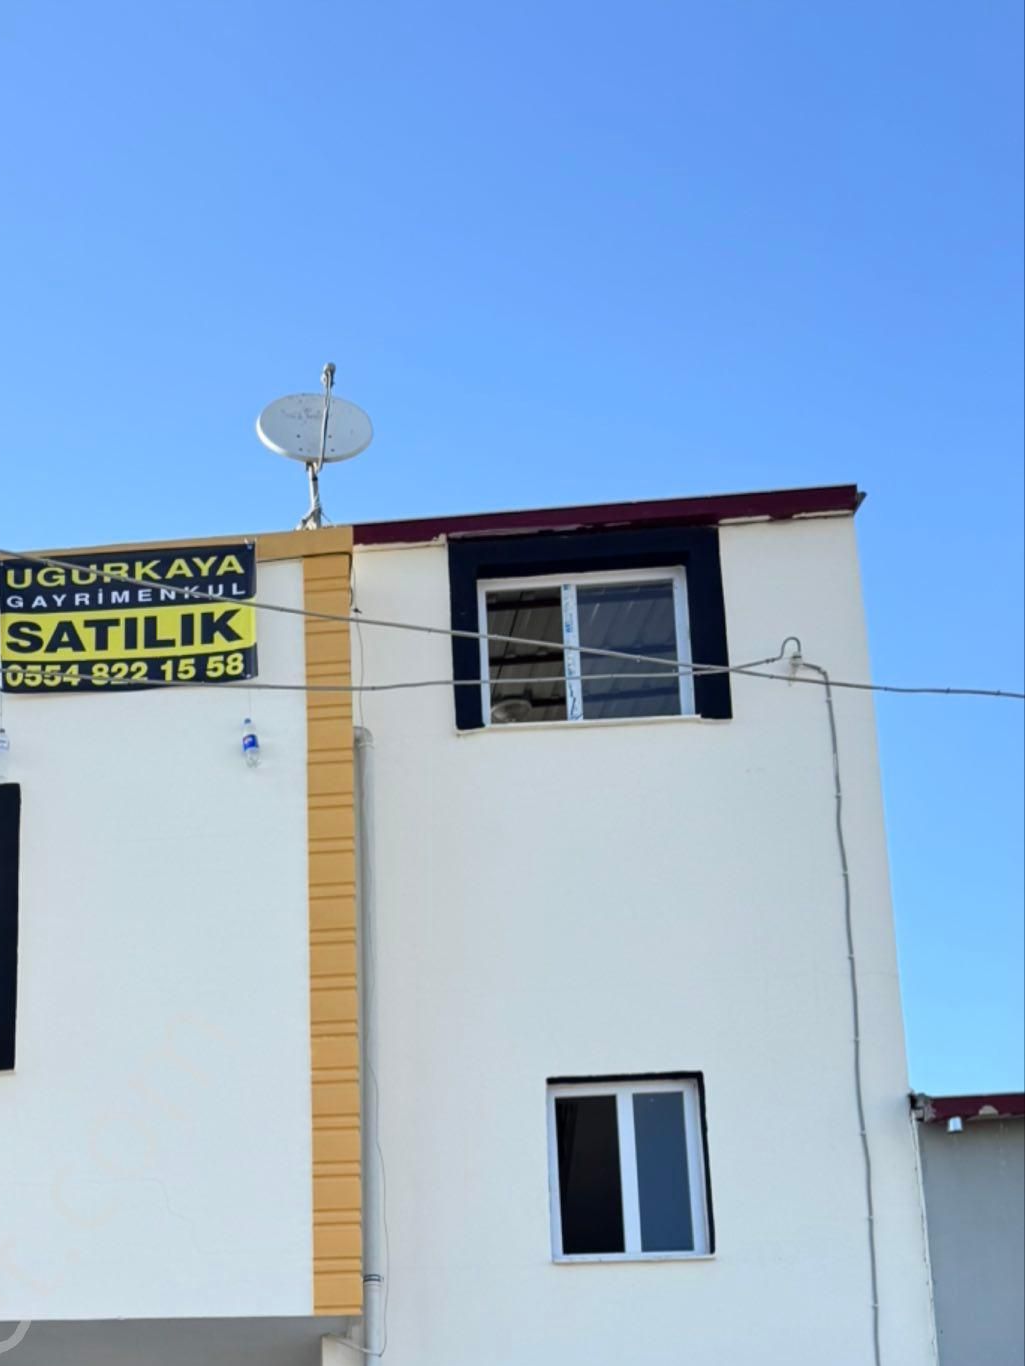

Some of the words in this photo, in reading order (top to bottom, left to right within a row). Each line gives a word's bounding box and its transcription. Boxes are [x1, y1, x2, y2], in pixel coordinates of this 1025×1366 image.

[5, 608, 245, 654] SATILIK
[5, 664, 81, 688] 0554
[91, 660, 148, 686] 822
[161, 658, 196, 683] 15
[206, 652, 245, 678] 58
